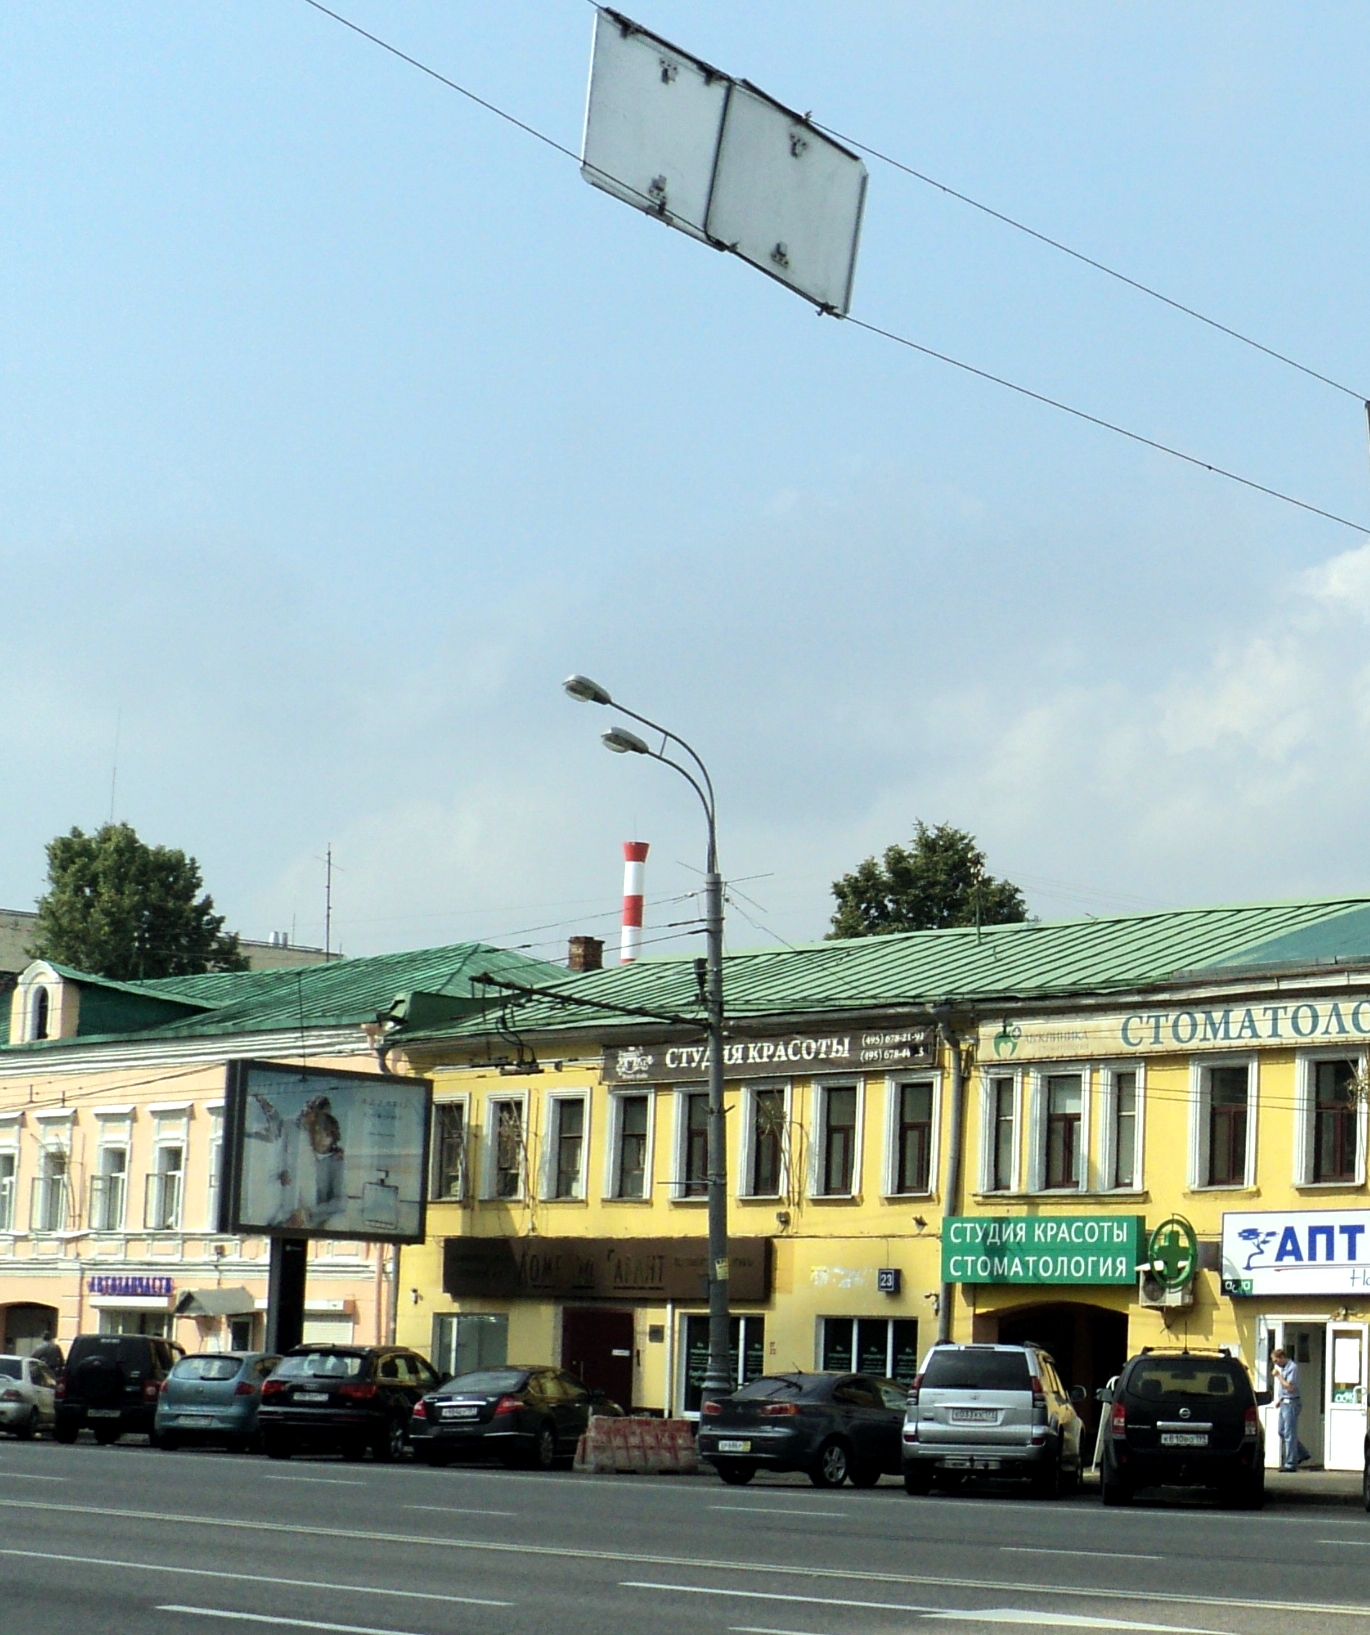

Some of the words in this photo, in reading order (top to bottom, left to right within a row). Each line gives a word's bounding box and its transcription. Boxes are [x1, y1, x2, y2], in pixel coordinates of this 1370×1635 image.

[747, 1037, 850, 1063] КРАСОТЫ
[949, 1222, 1026, 1246] СТУДИЯ
[1034, 1221, 1127, 1243] КРАСОТЫ
[949, 1256, 1127, 1277] СТОМАТОЛОГИЯ
[880, 1274, 892, 1287] 23
